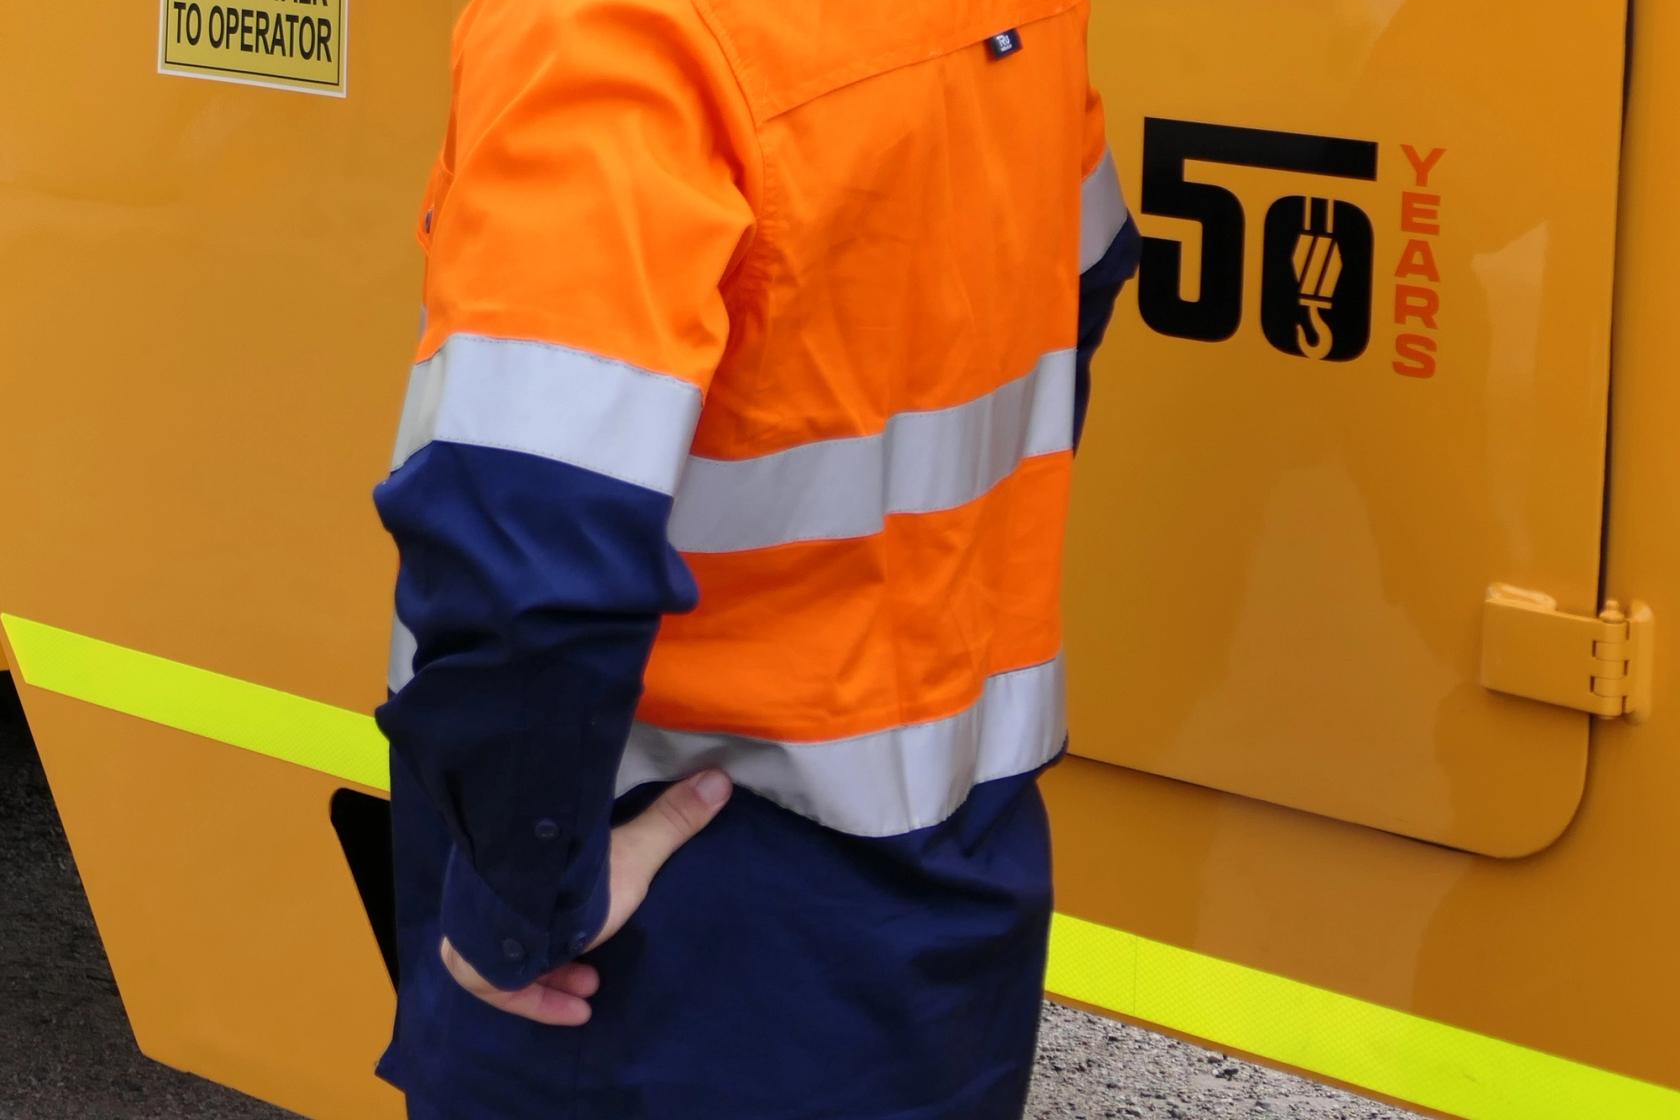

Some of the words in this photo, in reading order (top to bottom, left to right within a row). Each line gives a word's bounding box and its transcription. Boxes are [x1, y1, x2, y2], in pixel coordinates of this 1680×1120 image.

[174, 1, 202, 46] TO
[208, 6, 333, 63] OPERATOR
[1138, 116, 1379, 363] 50
[1392, 143, 1448, 379] YEARS
